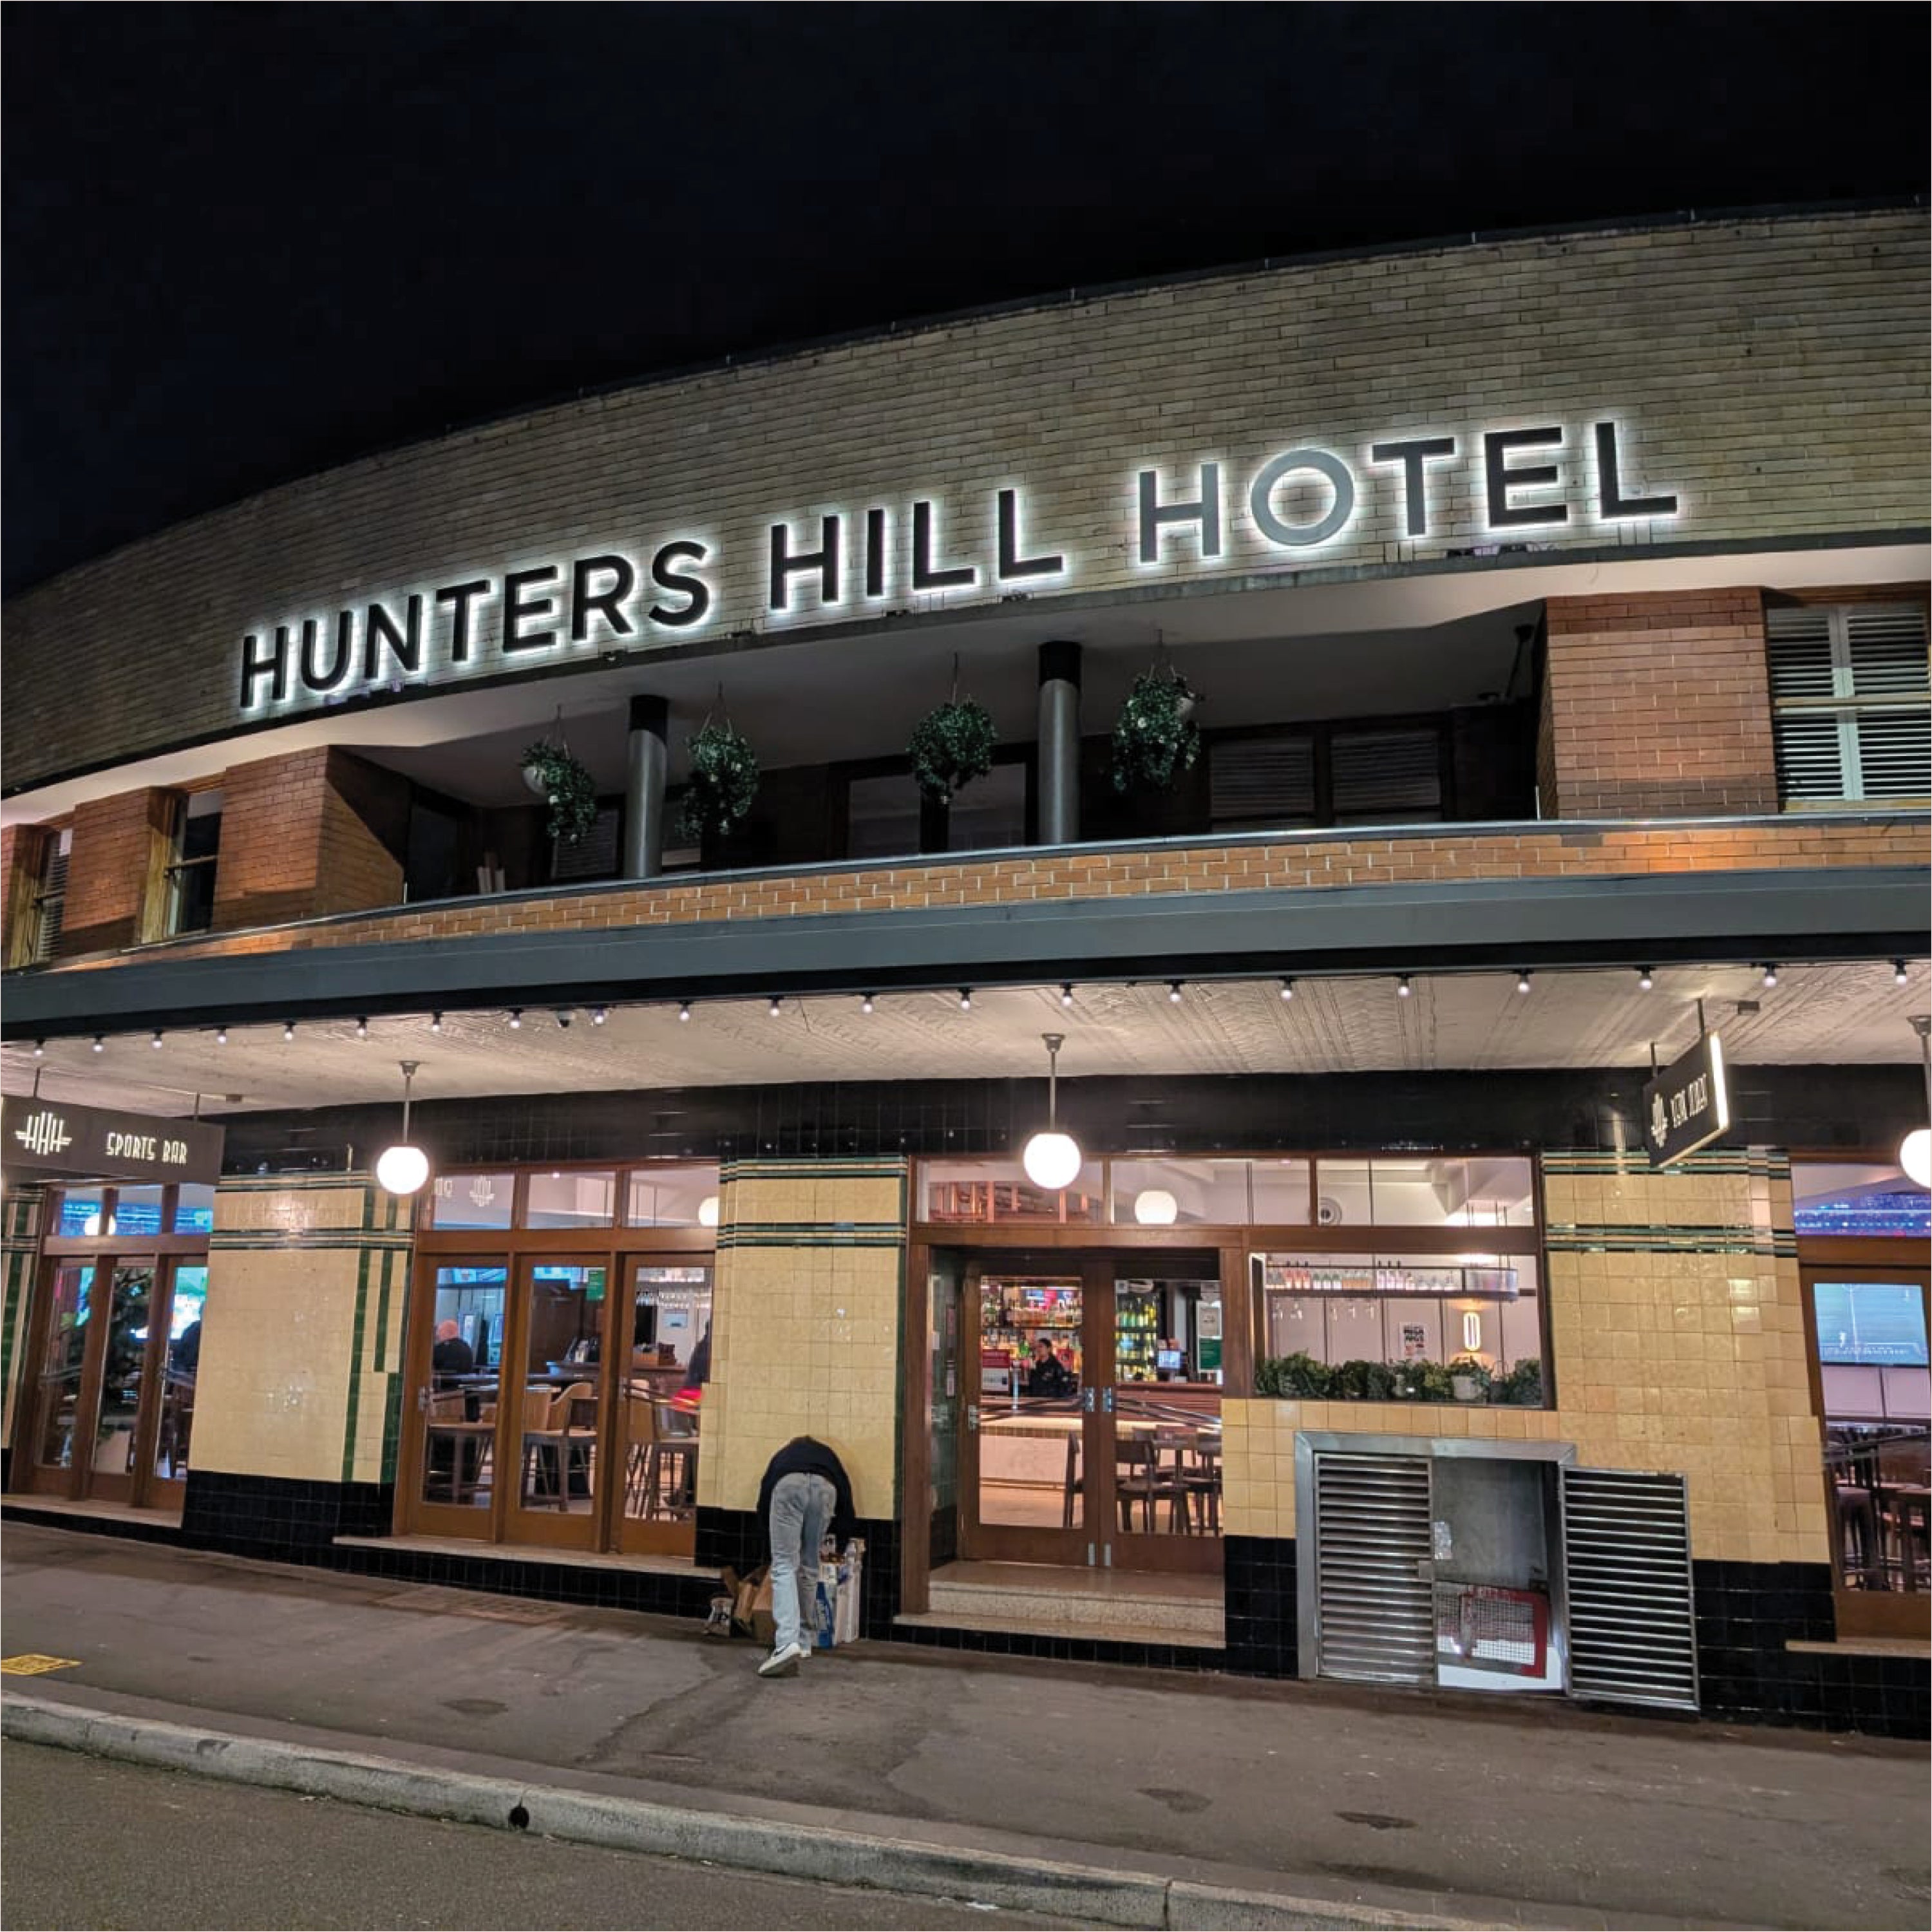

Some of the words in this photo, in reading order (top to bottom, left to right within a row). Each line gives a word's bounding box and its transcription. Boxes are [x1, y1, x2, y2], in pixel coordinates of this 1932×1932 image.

[240, 540, 710, 708] HUNTERS
[770, 488, 1064, 610] HILL
[1138, 421, 1677, 564] HOTEL
[106, 1132, 157, 1160] SPORTS
[162, 1139, 187, 1164] BAR
